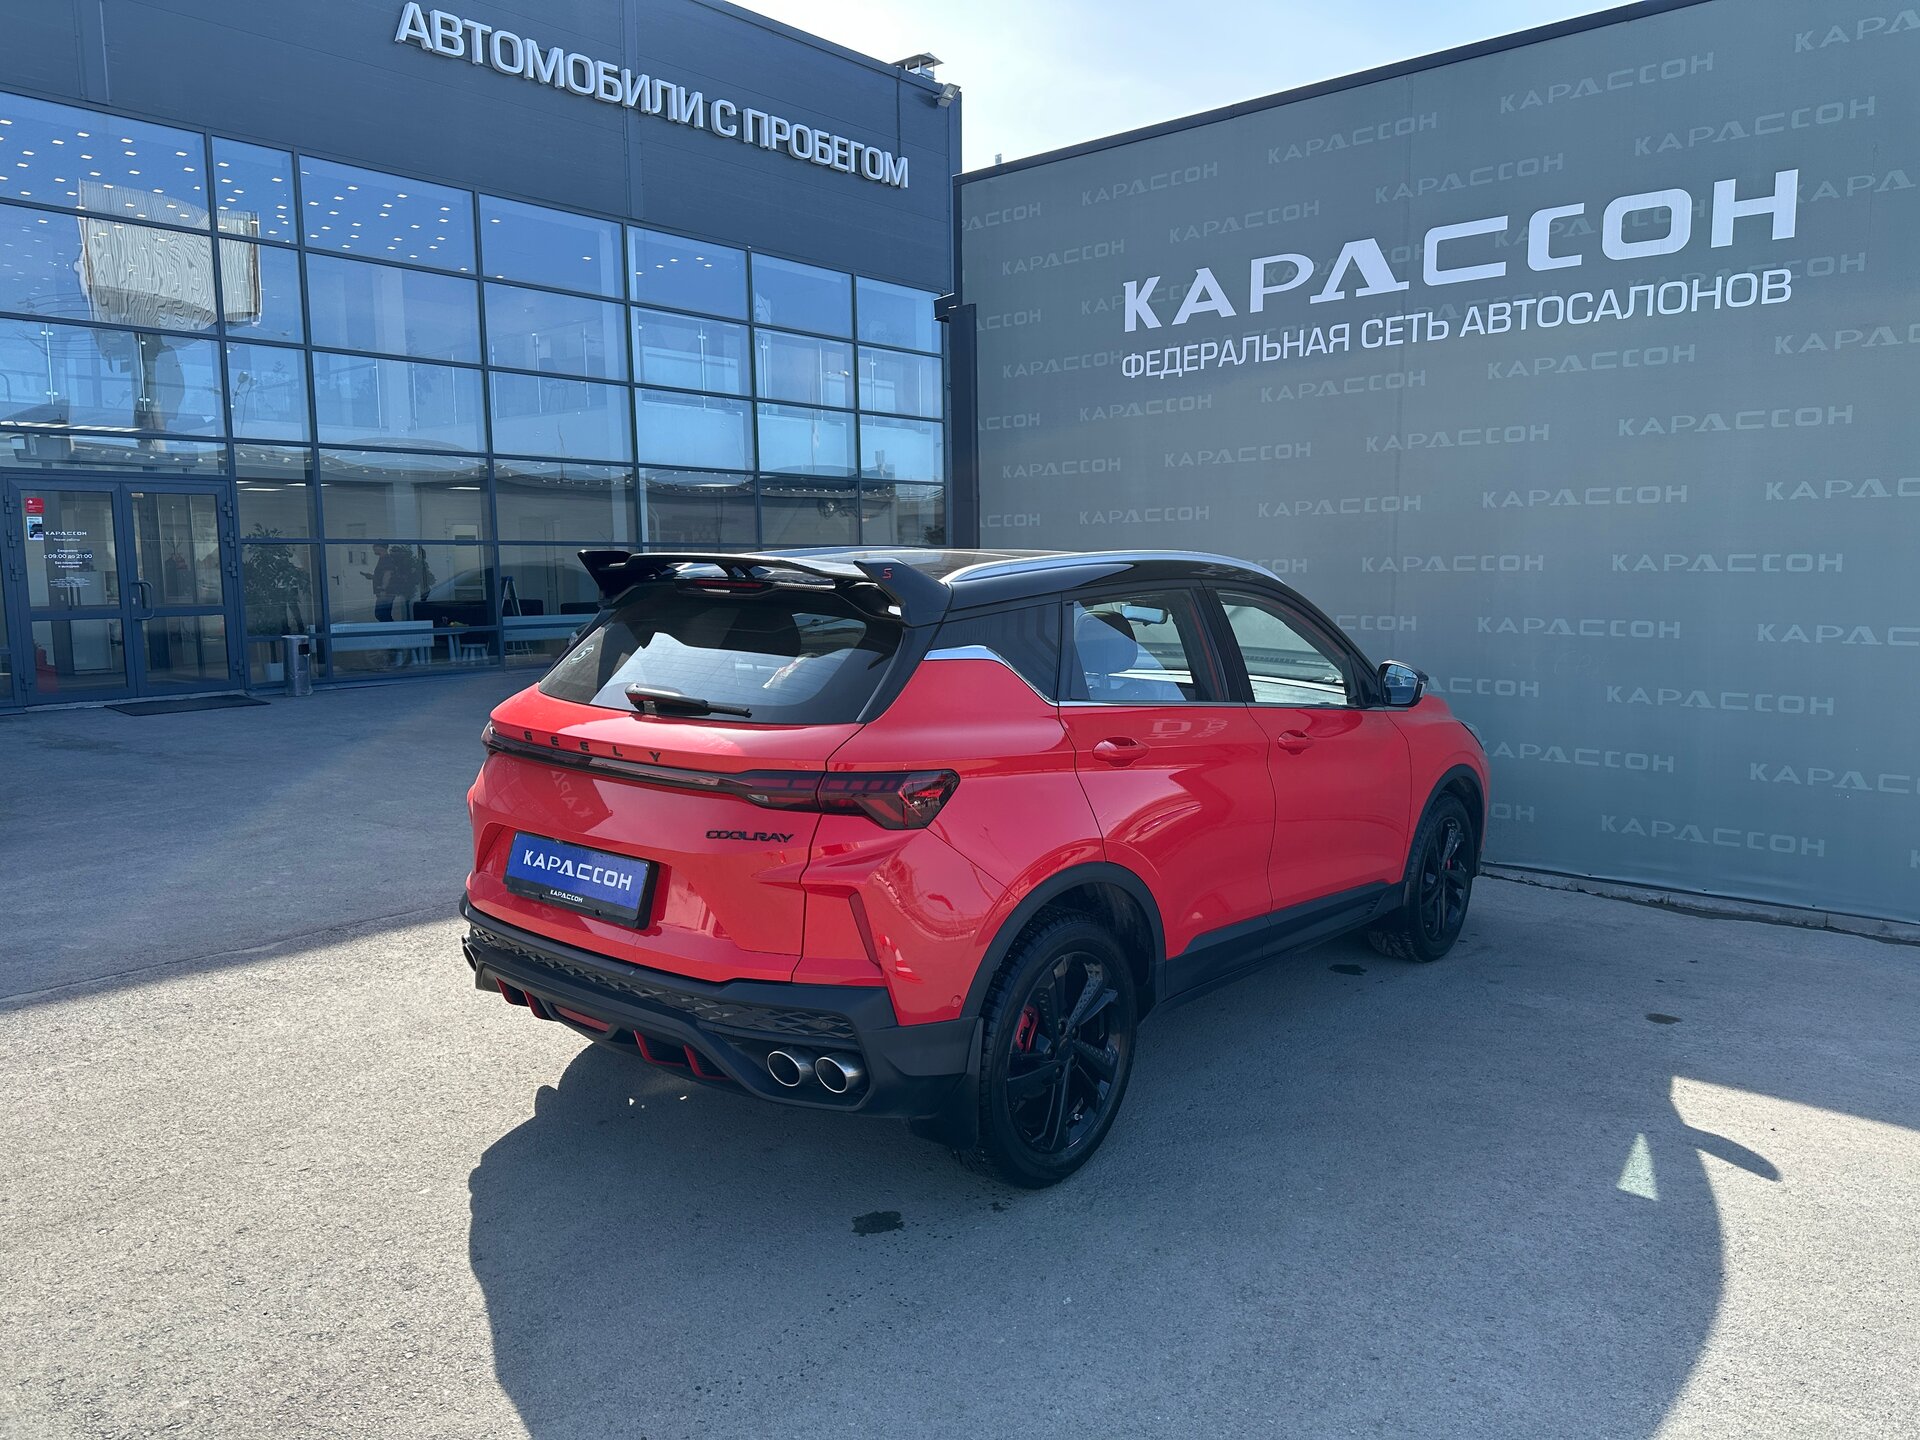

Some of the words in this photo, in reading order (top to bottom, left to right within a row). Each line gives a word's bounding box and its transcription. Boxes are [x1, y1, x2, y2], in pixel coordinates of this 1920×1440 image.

[395, 1, 703, 129] АВТОМОБИЛИ
[710, 99, 737, 138] С
[743, 107, 909, 189] ПРОБЕГОМ
[1122, 168, 1799, 333] КАРАССОН
[1121, 321, 1350, 380] ФЕДЕРАЛЬНАЯ
[1360, 310, 1450, 351] СЕТЬ
[1459, 268, 1792, 338] АВТОСАЛОНОВ
[524, 730, 661, 763] GEELY
[522, 849, 633, 891] КАРАССОН
[705, 830, 794, 843] COOLRAY
